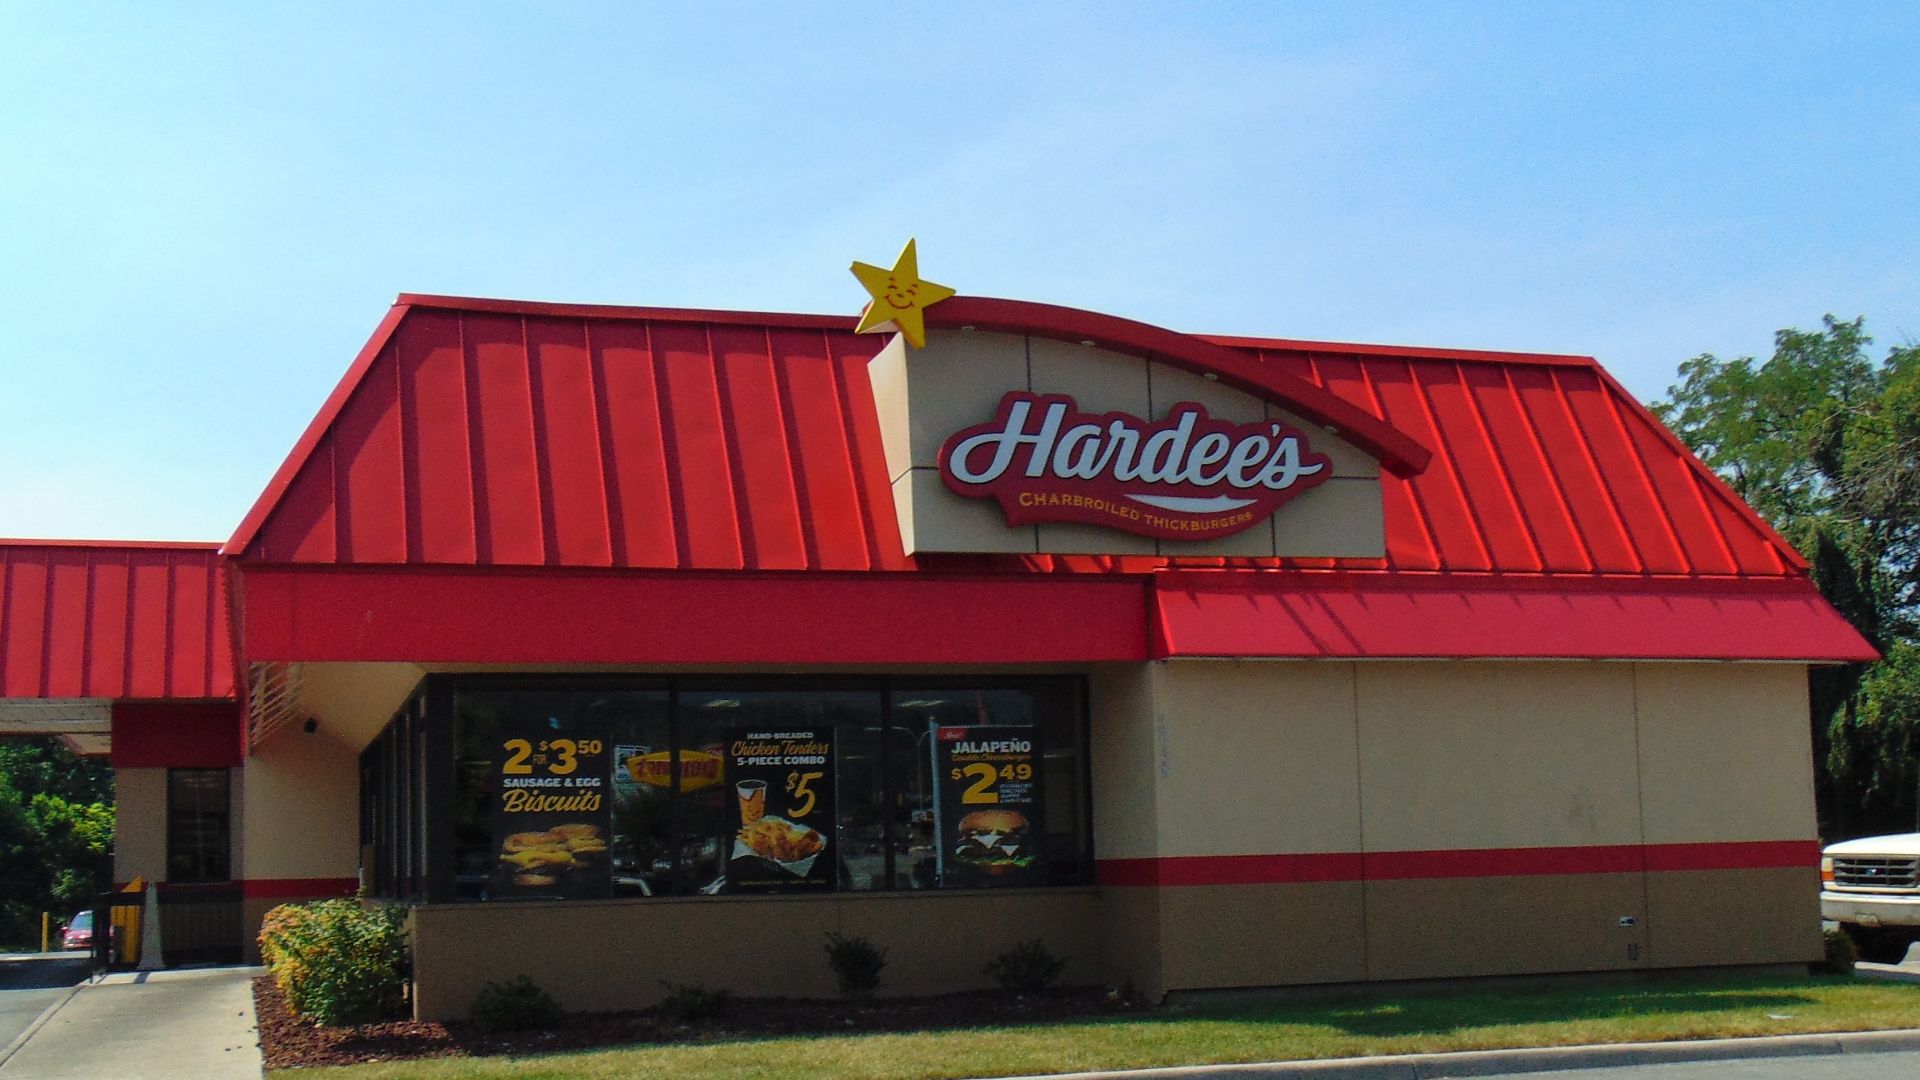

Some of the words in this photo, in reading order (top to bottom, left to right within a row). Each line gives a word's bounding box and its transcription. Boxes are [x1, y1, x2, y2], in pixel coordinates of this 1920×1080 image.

[949, 401, 1324, 490] Hardee's
[1019, 492, 1140, 520] CHARBROILED
[1144, 511, 1253, 531] THICKBURGERS
[747, 732, 814, 740] HAND-BREADED
[731, 741, 780, 757] Chicken
[781, 740, 829, 755] Tenders
[951, 738, 1031, 754] JALAPEÑO
[502, 738, 533, 775] 2
[737, 756, 782, 766] 5-PIECE
[783, 756, 826, 765] COMBO
[503, 778, 562, 788] SAUSAGE
[563, 778, 574, 788] &
[575, 778, 601, 788] EGG
[502, 788, 602, 813] Biscuits
